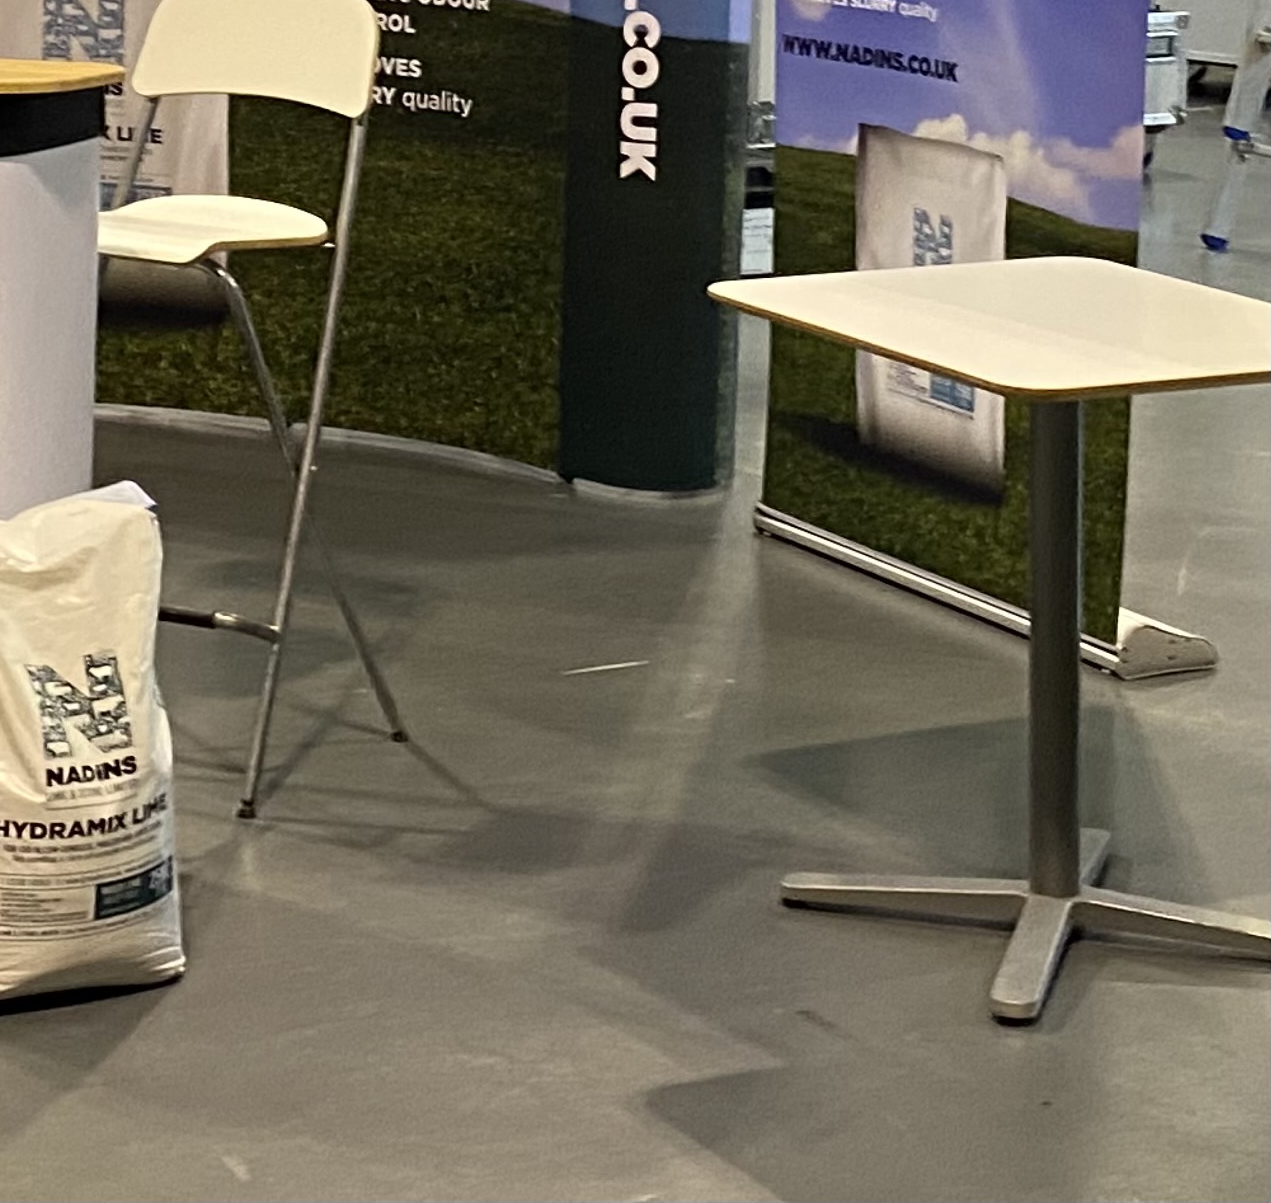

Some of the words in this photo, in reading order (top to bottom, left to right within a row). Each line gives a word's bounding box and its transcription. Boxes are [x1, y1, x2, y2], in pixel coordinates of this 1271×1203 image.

[782, 34, 959, 82] WWW.NADINS.CO.UK
[402, 90, 473, 118] quality
[131, 792, 169, 826] LIME
